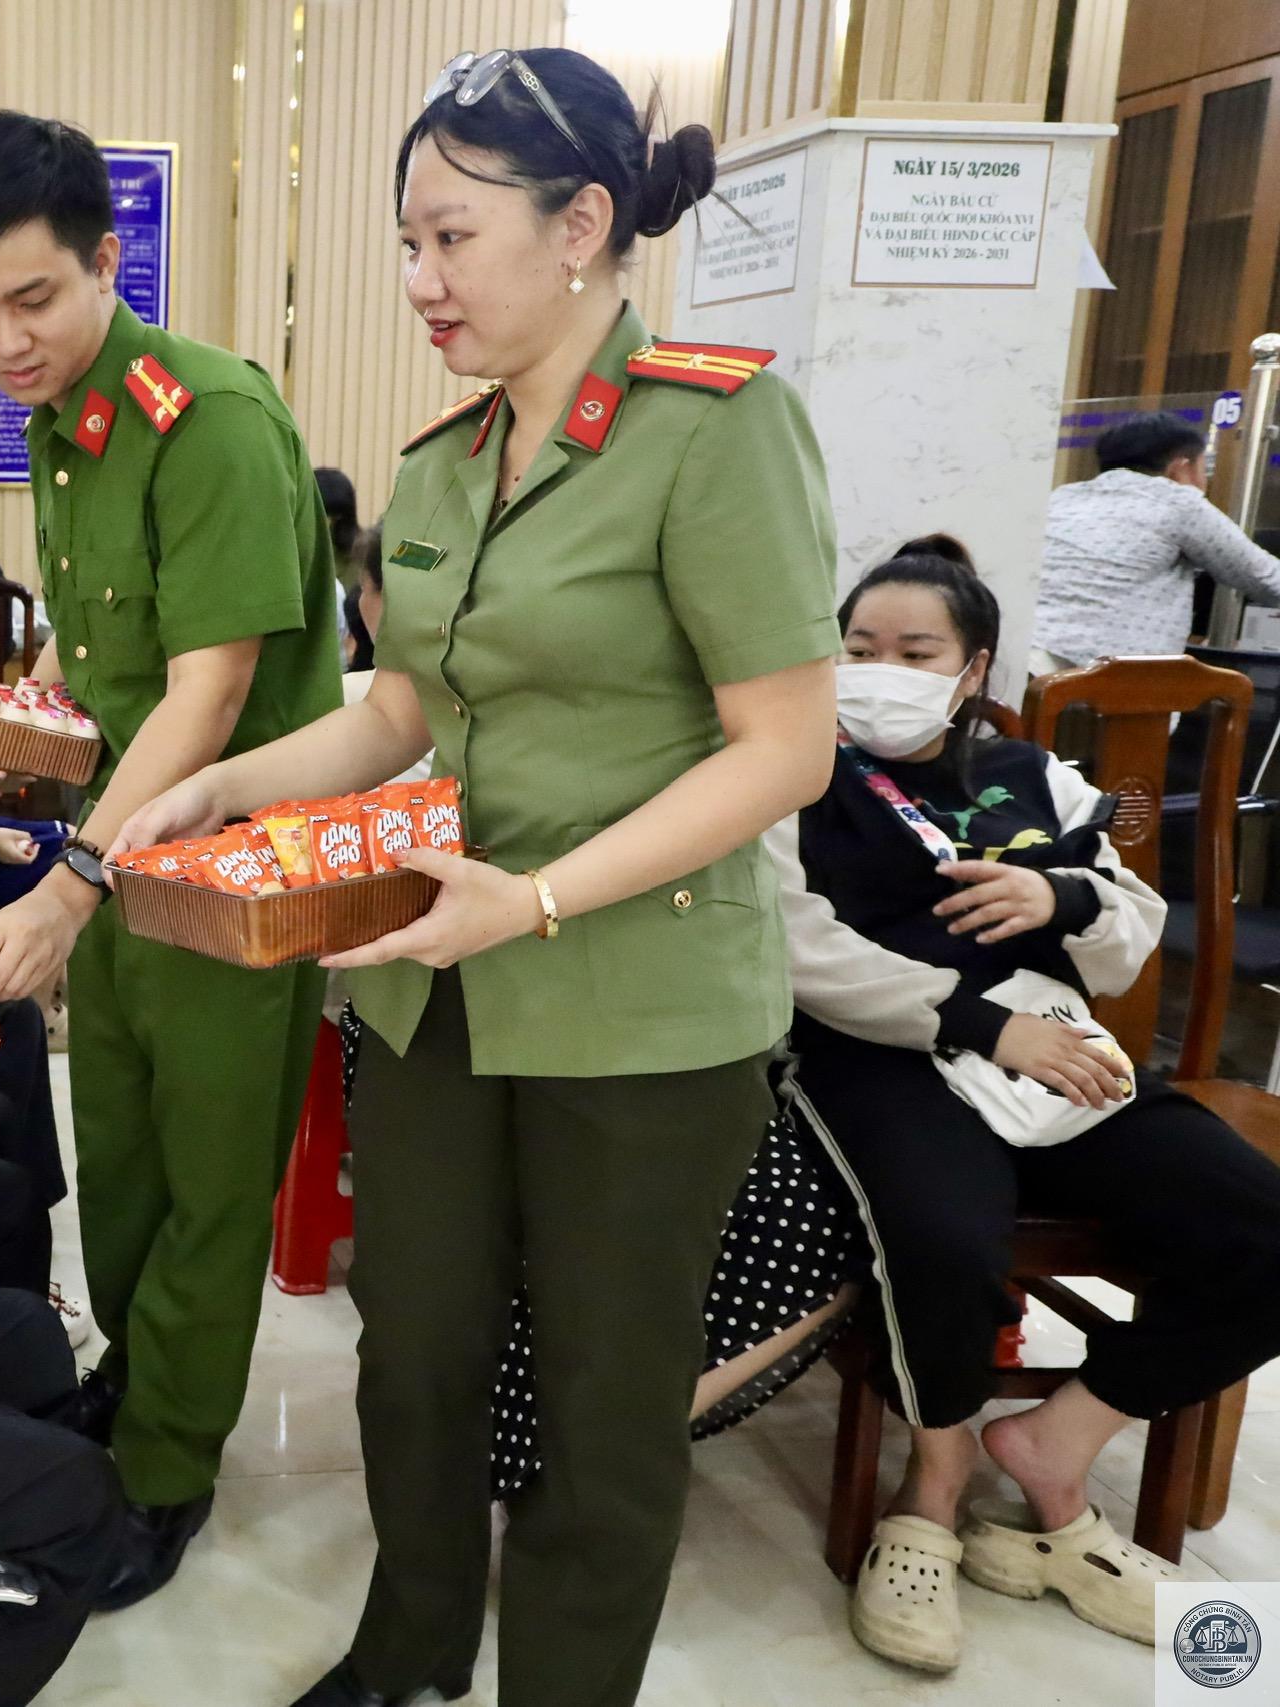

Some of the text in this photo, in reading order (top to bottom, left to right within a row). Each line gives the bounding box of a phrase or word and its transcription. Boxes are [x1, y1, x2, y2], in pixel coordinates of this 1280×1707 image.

[893, 156, 936, 176] NGÀY
[911, 192, 949, 207] NGÀY
[1014, 214, 1034, 225] XVI
[942, 230, 979, 242] HĐND
[953, 247, 977, 259] 2026
[986, 248, 1009, 260] 2031
[1211, 396, 1242, 425] 05
[376, 808, 413, 840] LÀNG
[422, 804, 461, 833] LÀNG
[320, 821, 362, 854] LÀNG
[431, 823, 461, 849] GẠO
[327, 844, 362, 869] GẠO
